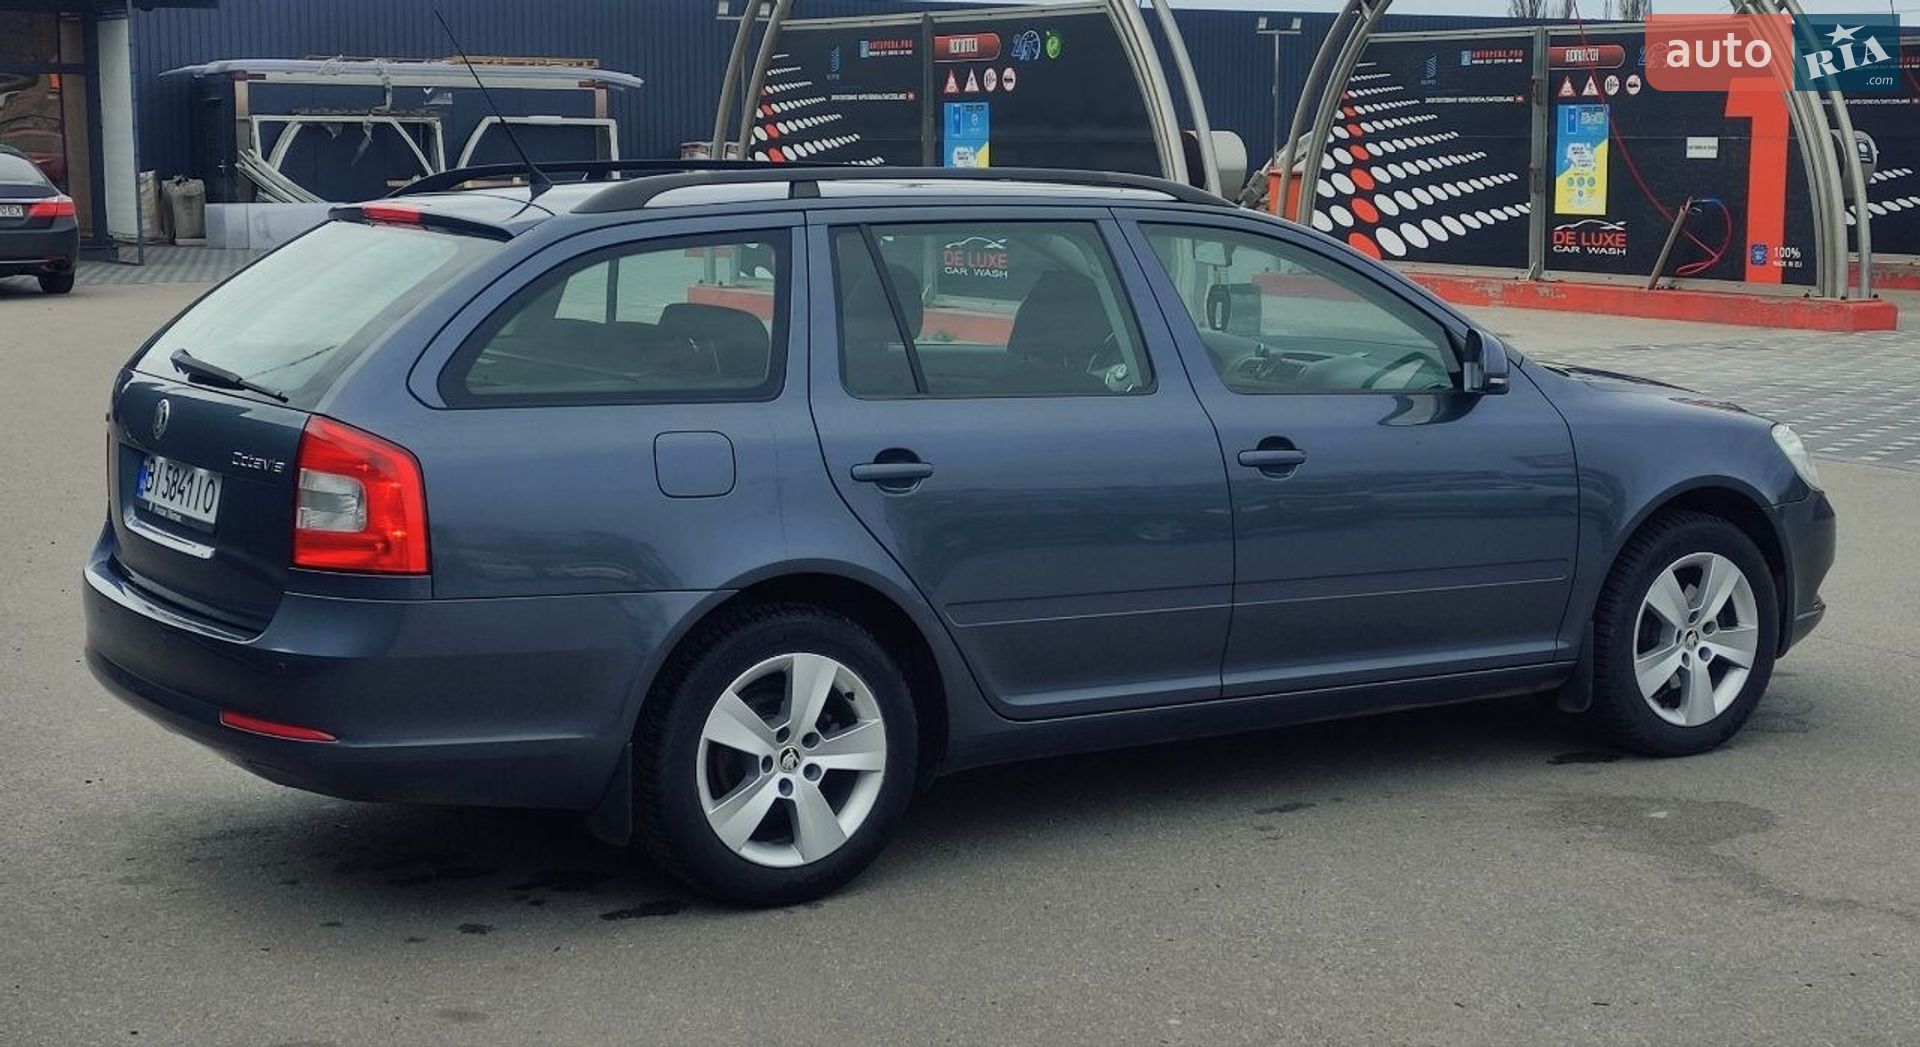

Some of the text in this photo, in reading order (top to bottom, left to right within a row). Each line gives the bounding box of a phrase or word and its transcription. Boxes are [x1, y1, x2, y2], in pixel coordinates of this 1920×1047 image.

[1725, 77, 1789, 284] 1
[1553, 231, 1627, 247] DE LUXE
[1552, 245, 1627, 256] CAR WASH
[1774, 246, 1801, 259] 100%
[944, 250, 1009, 269] DE LUXE
[944, 267, 1009, 279] CAR WASH
